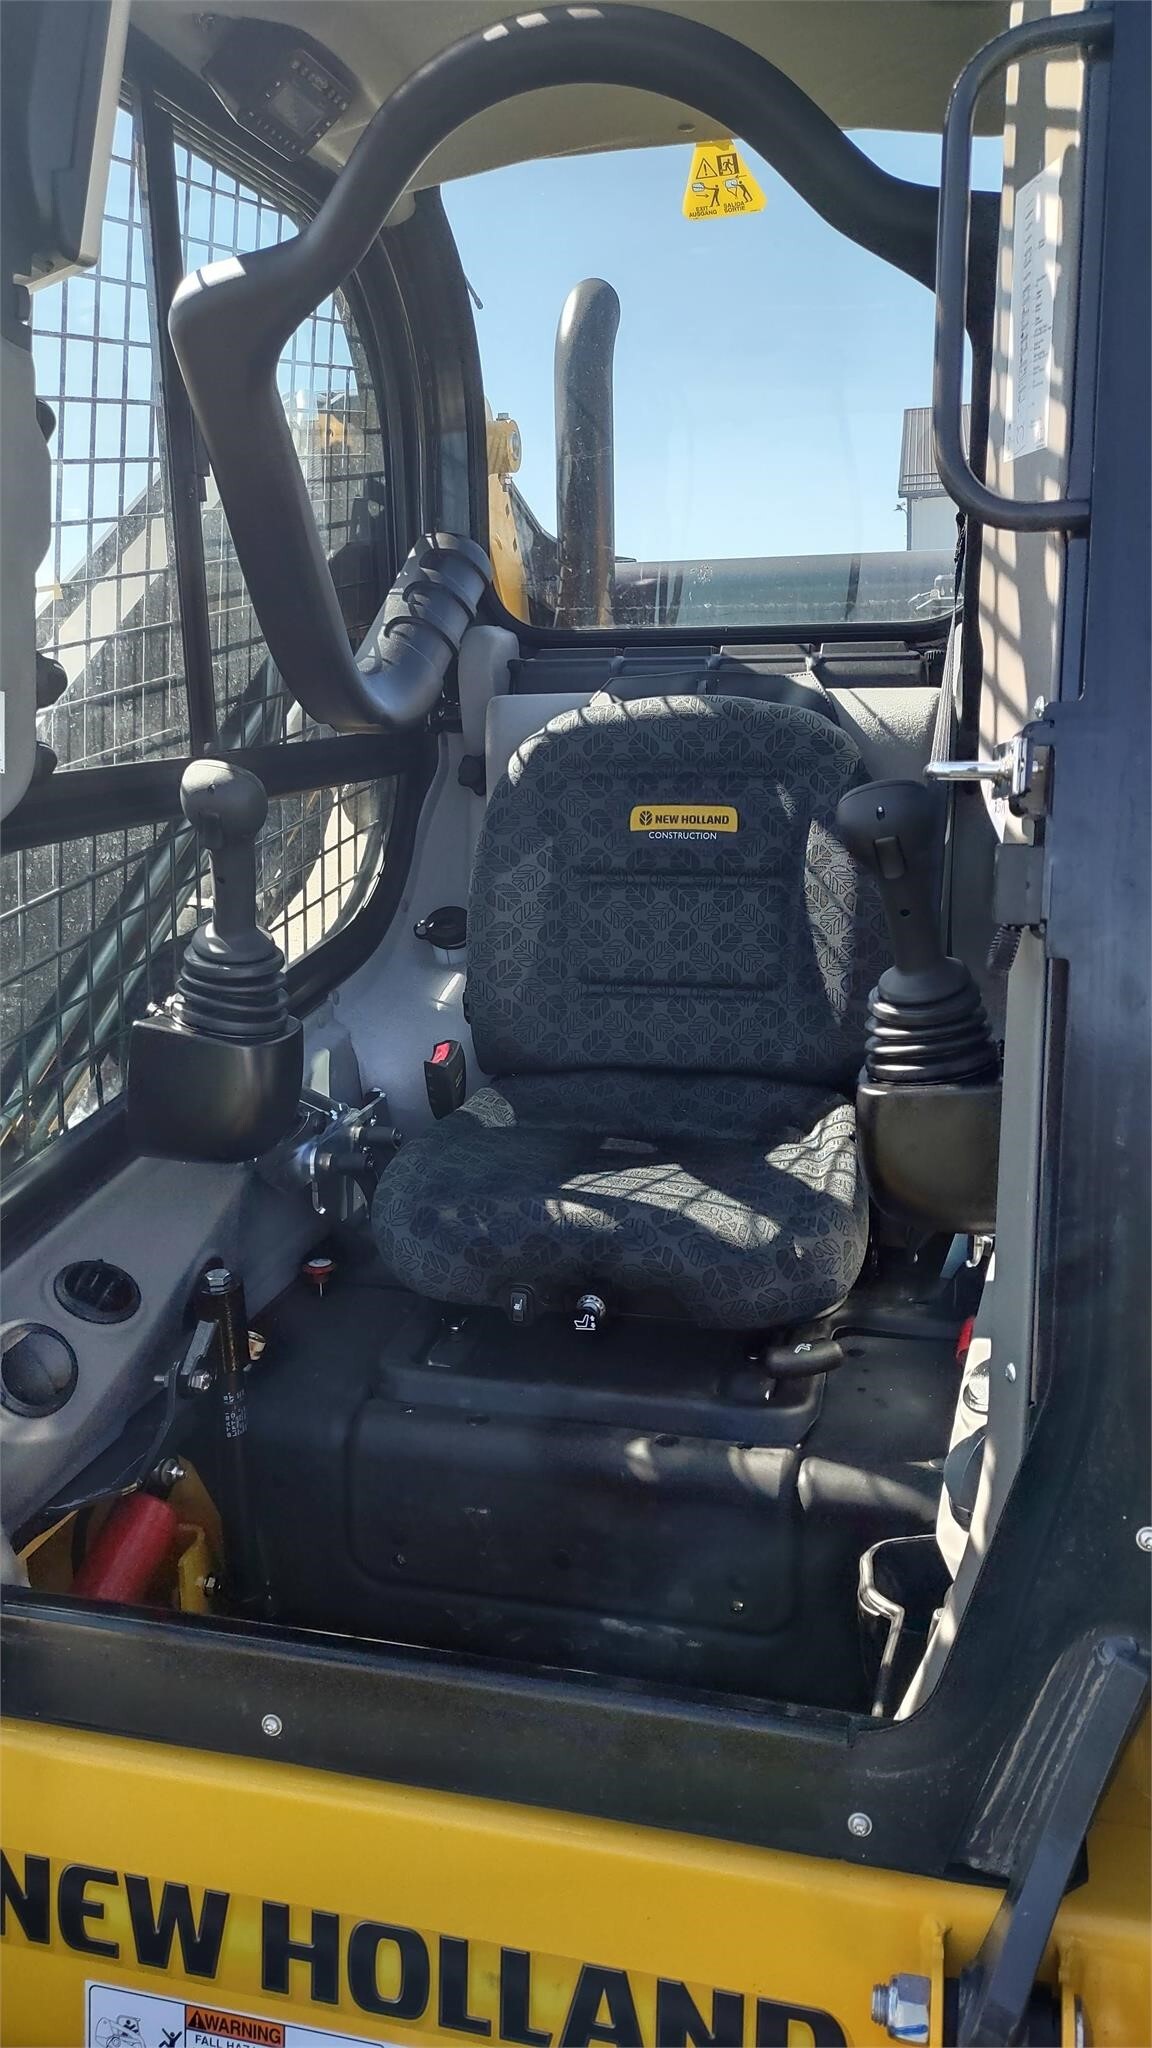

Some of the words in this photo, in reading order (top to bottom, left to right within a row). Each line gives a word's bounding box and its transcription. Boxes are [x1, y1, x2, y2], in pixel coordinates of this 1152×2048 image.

[655, 815, 679, 825] NEW
[681, 815, 729, 825] HOLLAND
[648, 831, 717, 840] CONSTRUCTION
[0, 1850, 230, 1980] NEW
[261, 1900, 848, 2048] HOLLAND
[204, 2013, 281, 2044] WARNING
[195, 2034, 222, 2048] FALL
